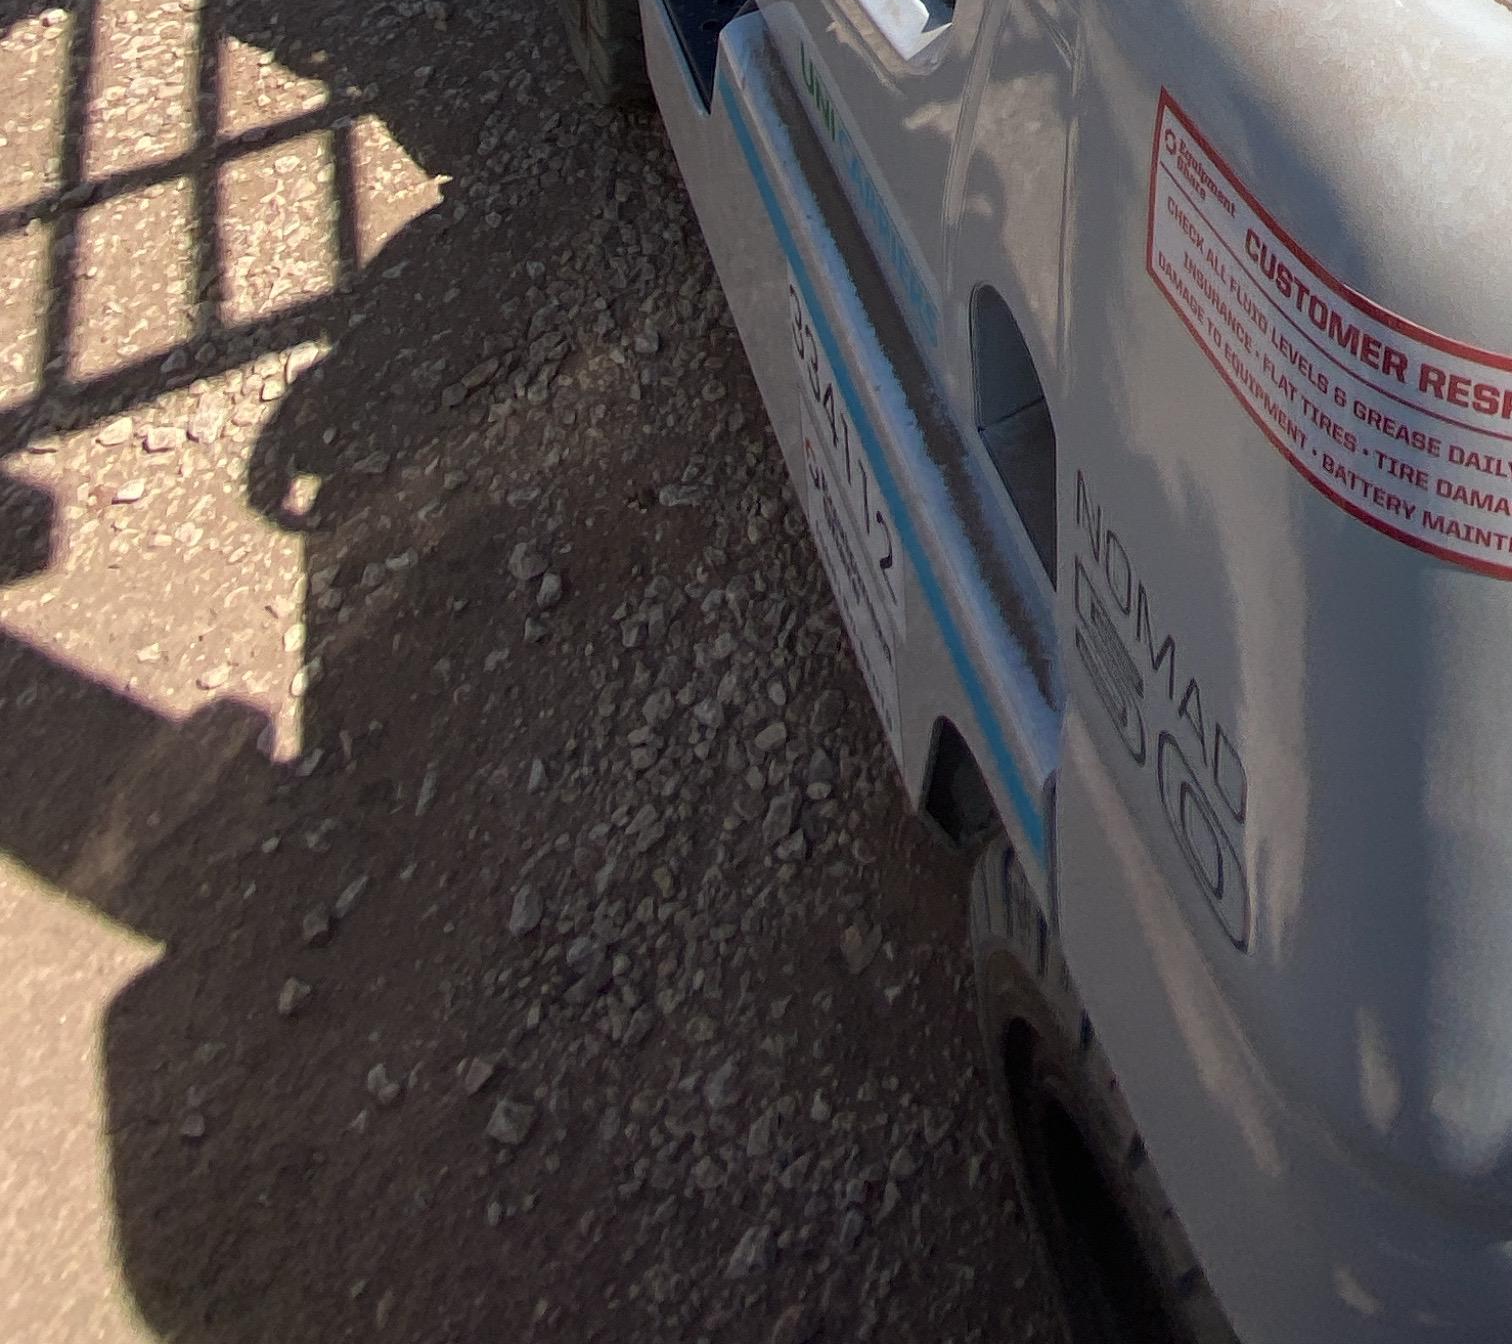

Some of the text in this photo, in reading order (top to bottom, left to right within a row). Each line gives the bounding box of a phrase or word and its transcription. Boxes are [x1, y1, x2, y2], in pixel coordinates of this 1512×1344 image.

[1158, 250, 1206, 324] DAMAGE
[1206, 316, 1222, 348] TO
[1223, 341, 1309, 450] EQUIPMENT
[1321, 452, 1418, 522] BATTERY
[1167, 195, 1205, 255] CHECK
[1206, 248, 1229, 284] ALL
[1229, 275, 1269, 336] FLUID
[1271, 326, 1329, 395] LEVELS
[1352, 399, 1443, 459] GREASE
[1183, 251, 1252, 356] INSURANCE
[1262, 354, 1298, 402] FLAT
[1301, 395, 1358, 454] TIRES
[1374, 449, 1430, 491] TIRE
[1243, 227, 1409, 385] CUSTOMER
[1076, 468, 1248, 824] NOMAD
